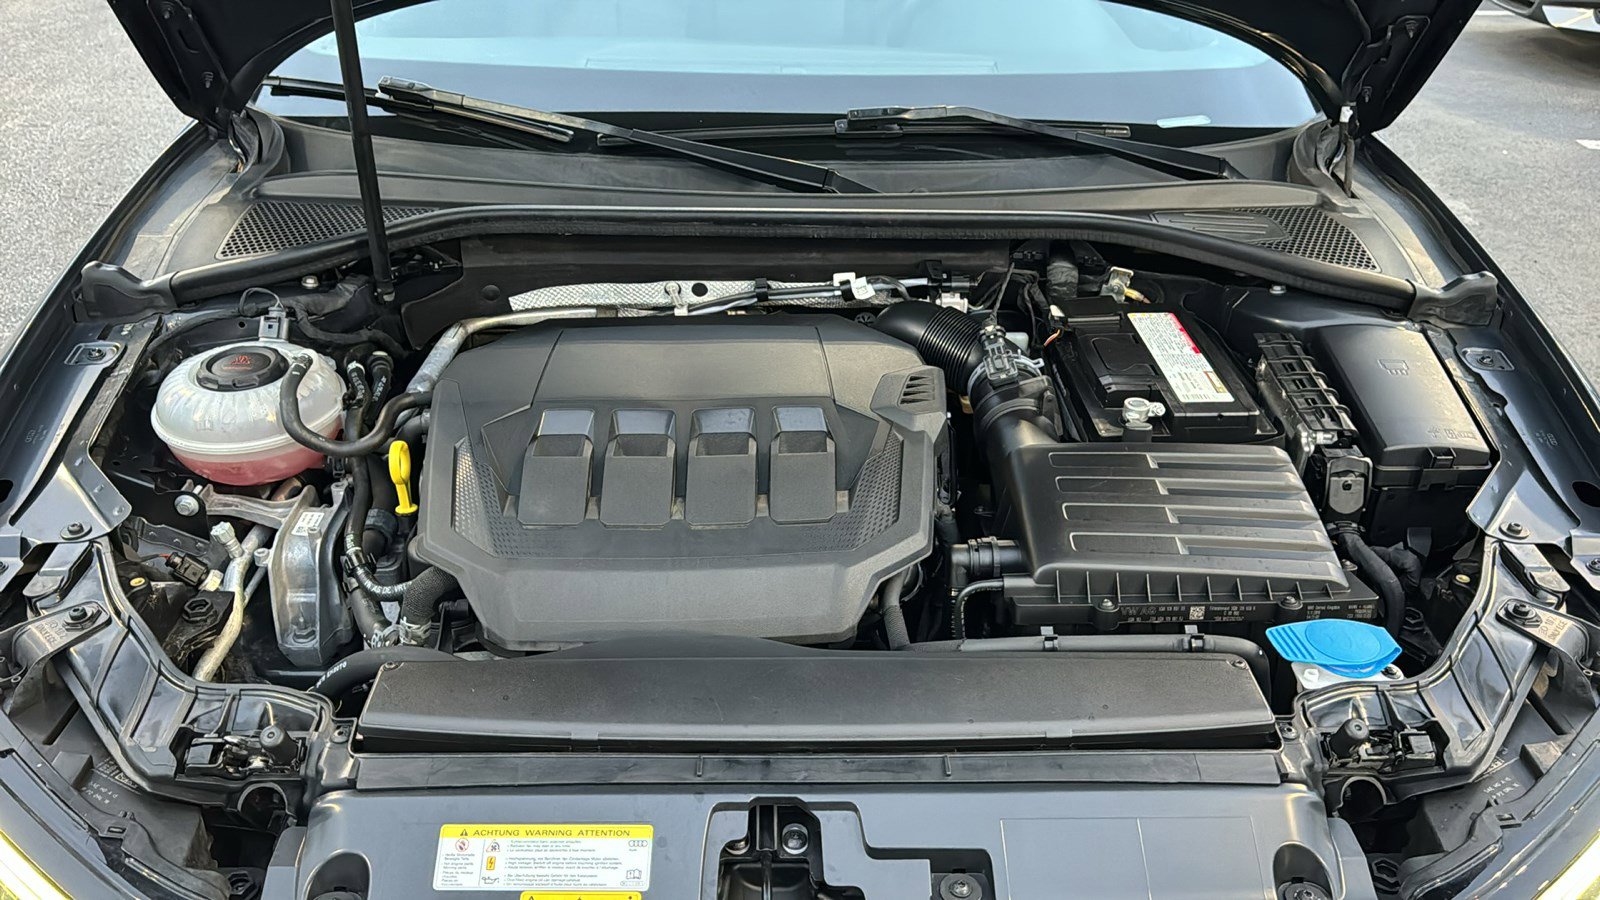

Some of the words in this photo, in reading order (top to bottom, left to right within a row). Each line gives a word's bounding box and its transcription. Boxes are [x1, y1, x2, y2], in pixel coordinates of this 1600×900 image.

[472, 829, 520, 837] ACHTUNG
[525, 829, 573, 837] WARNING
[577, 829, 631, 837] ATTENTION
